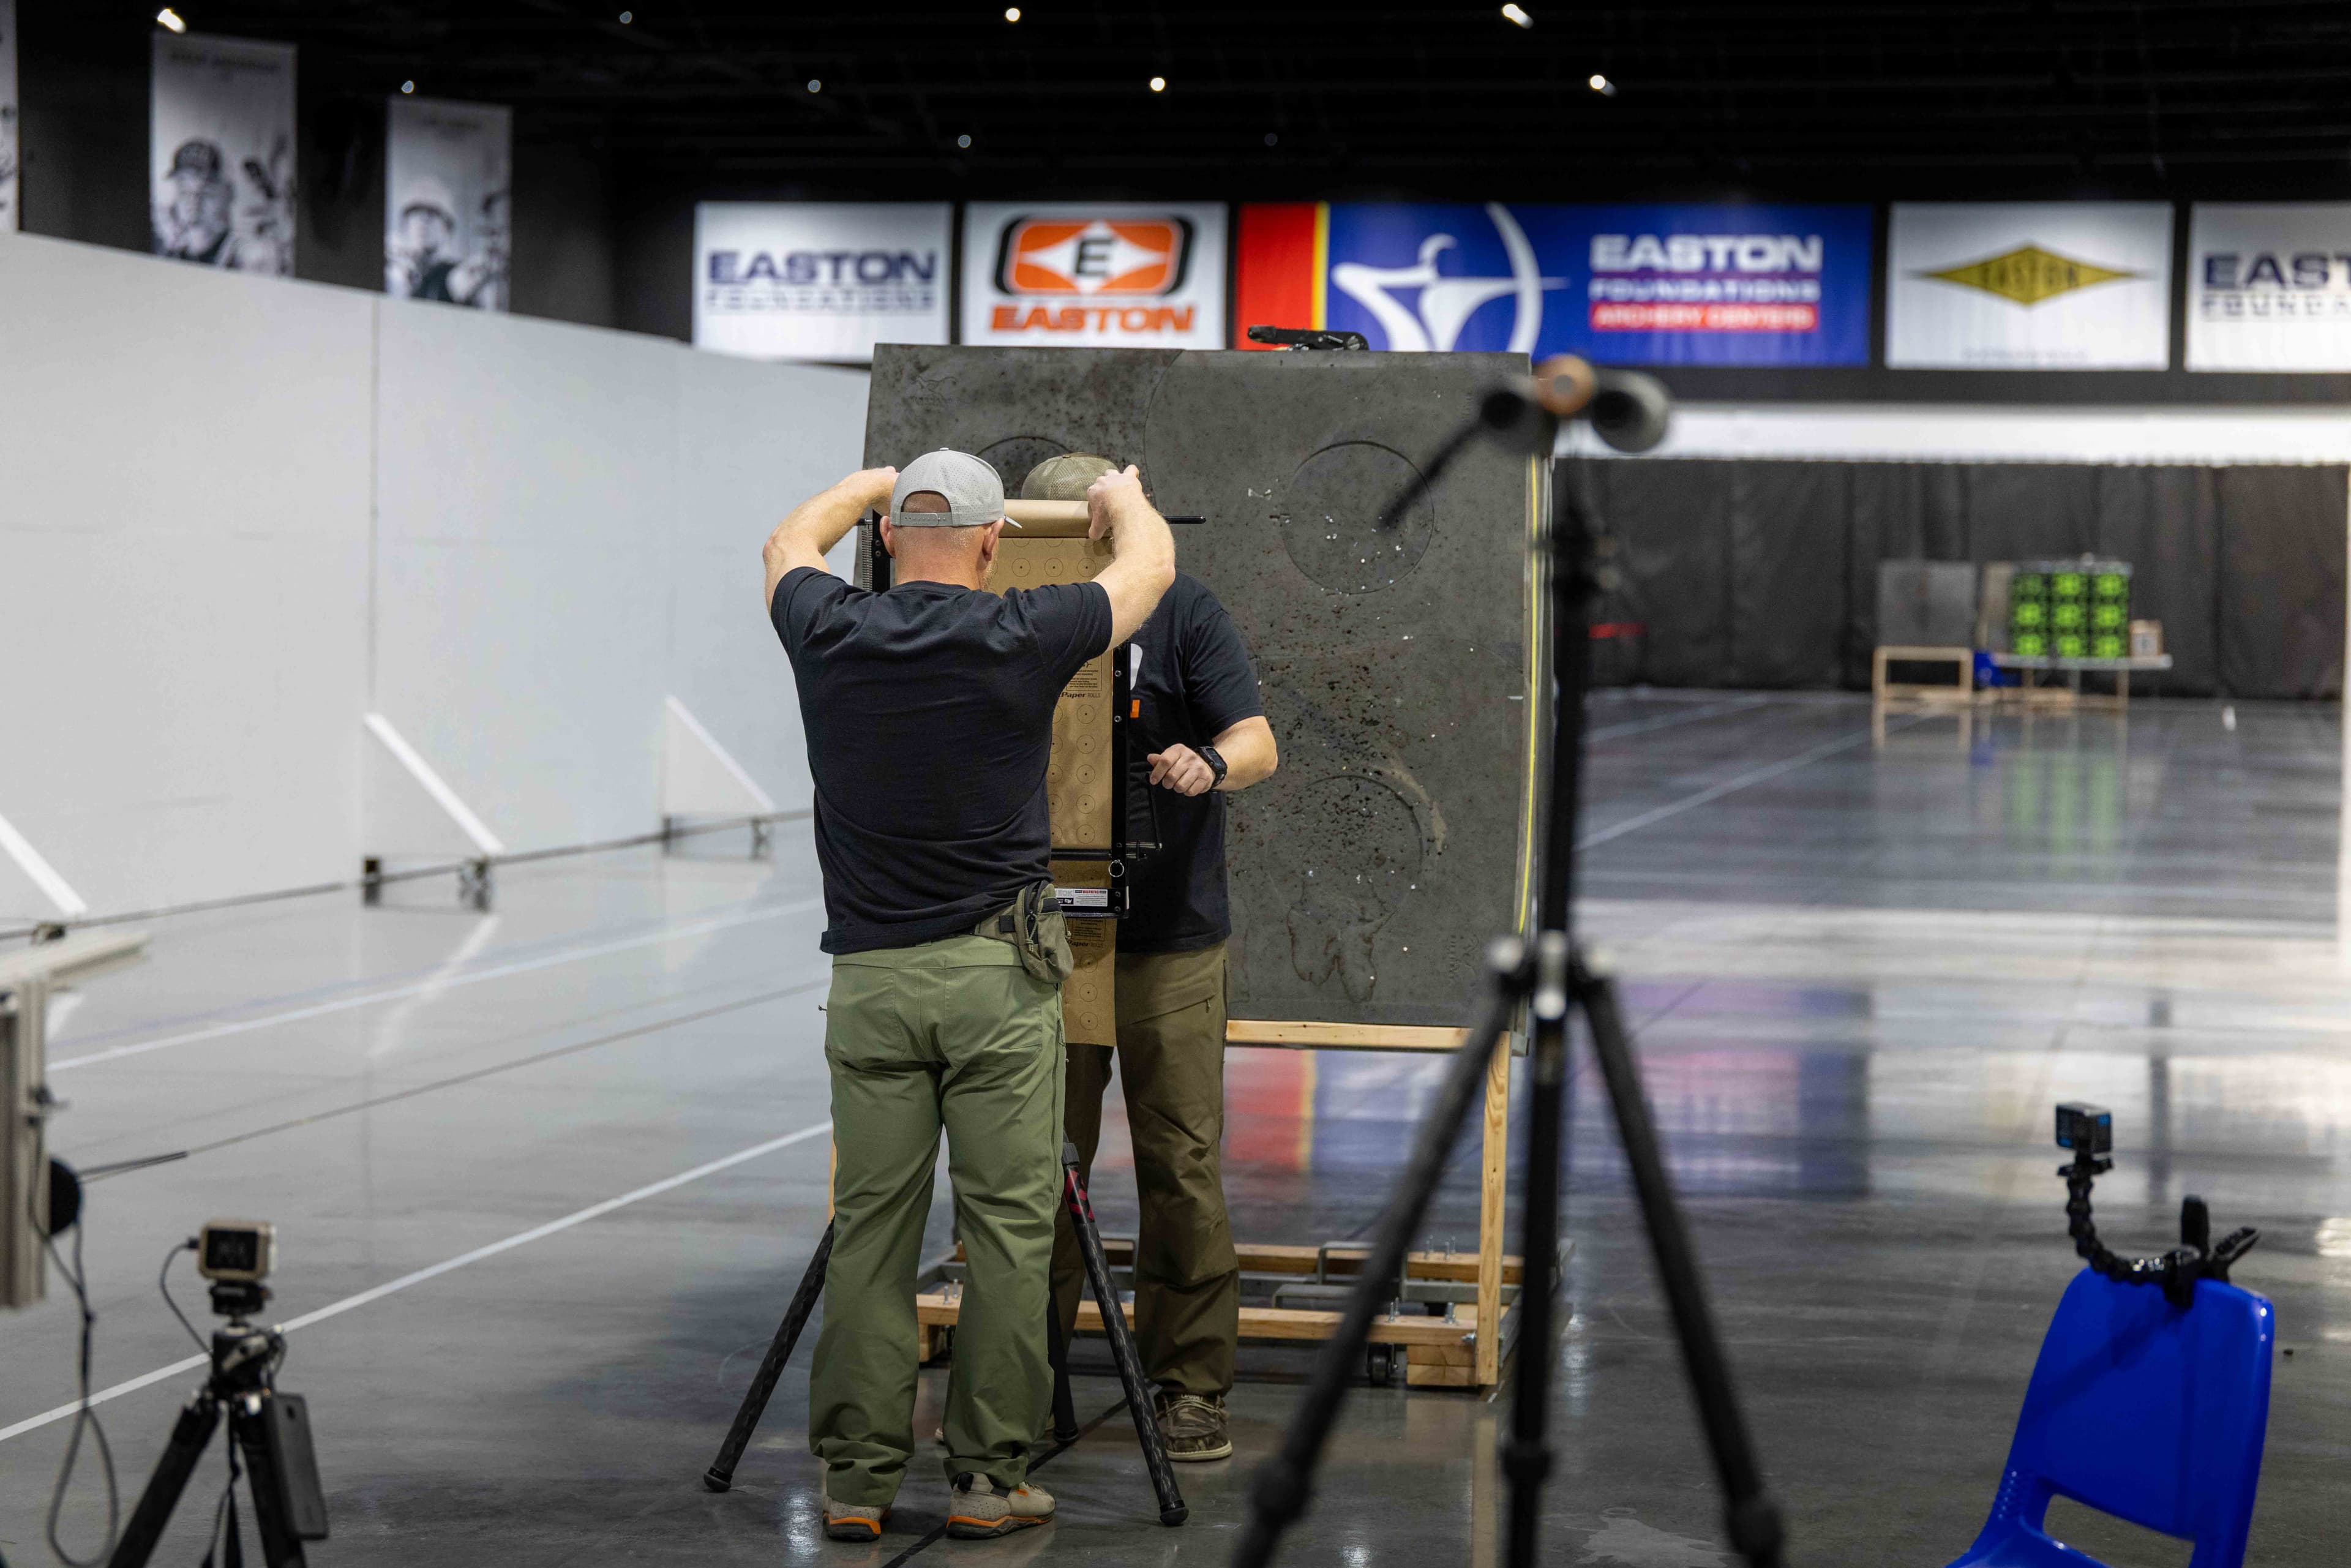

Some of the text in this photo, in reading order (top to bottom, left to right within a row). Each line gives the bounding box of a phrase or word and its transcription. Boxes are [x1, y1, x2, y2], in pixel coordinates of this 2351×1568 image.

[1076, 237, 1116, 276] E
[1590, 234, 1823, 271] EASTON
[708, 251, 934, 284] EASTON
[706, 289, 934, 311] FOUNDATIONS
[1588, 279, 1821, 301] FOUNDATIONS
[991, 306, 1197, 332] EASTON
